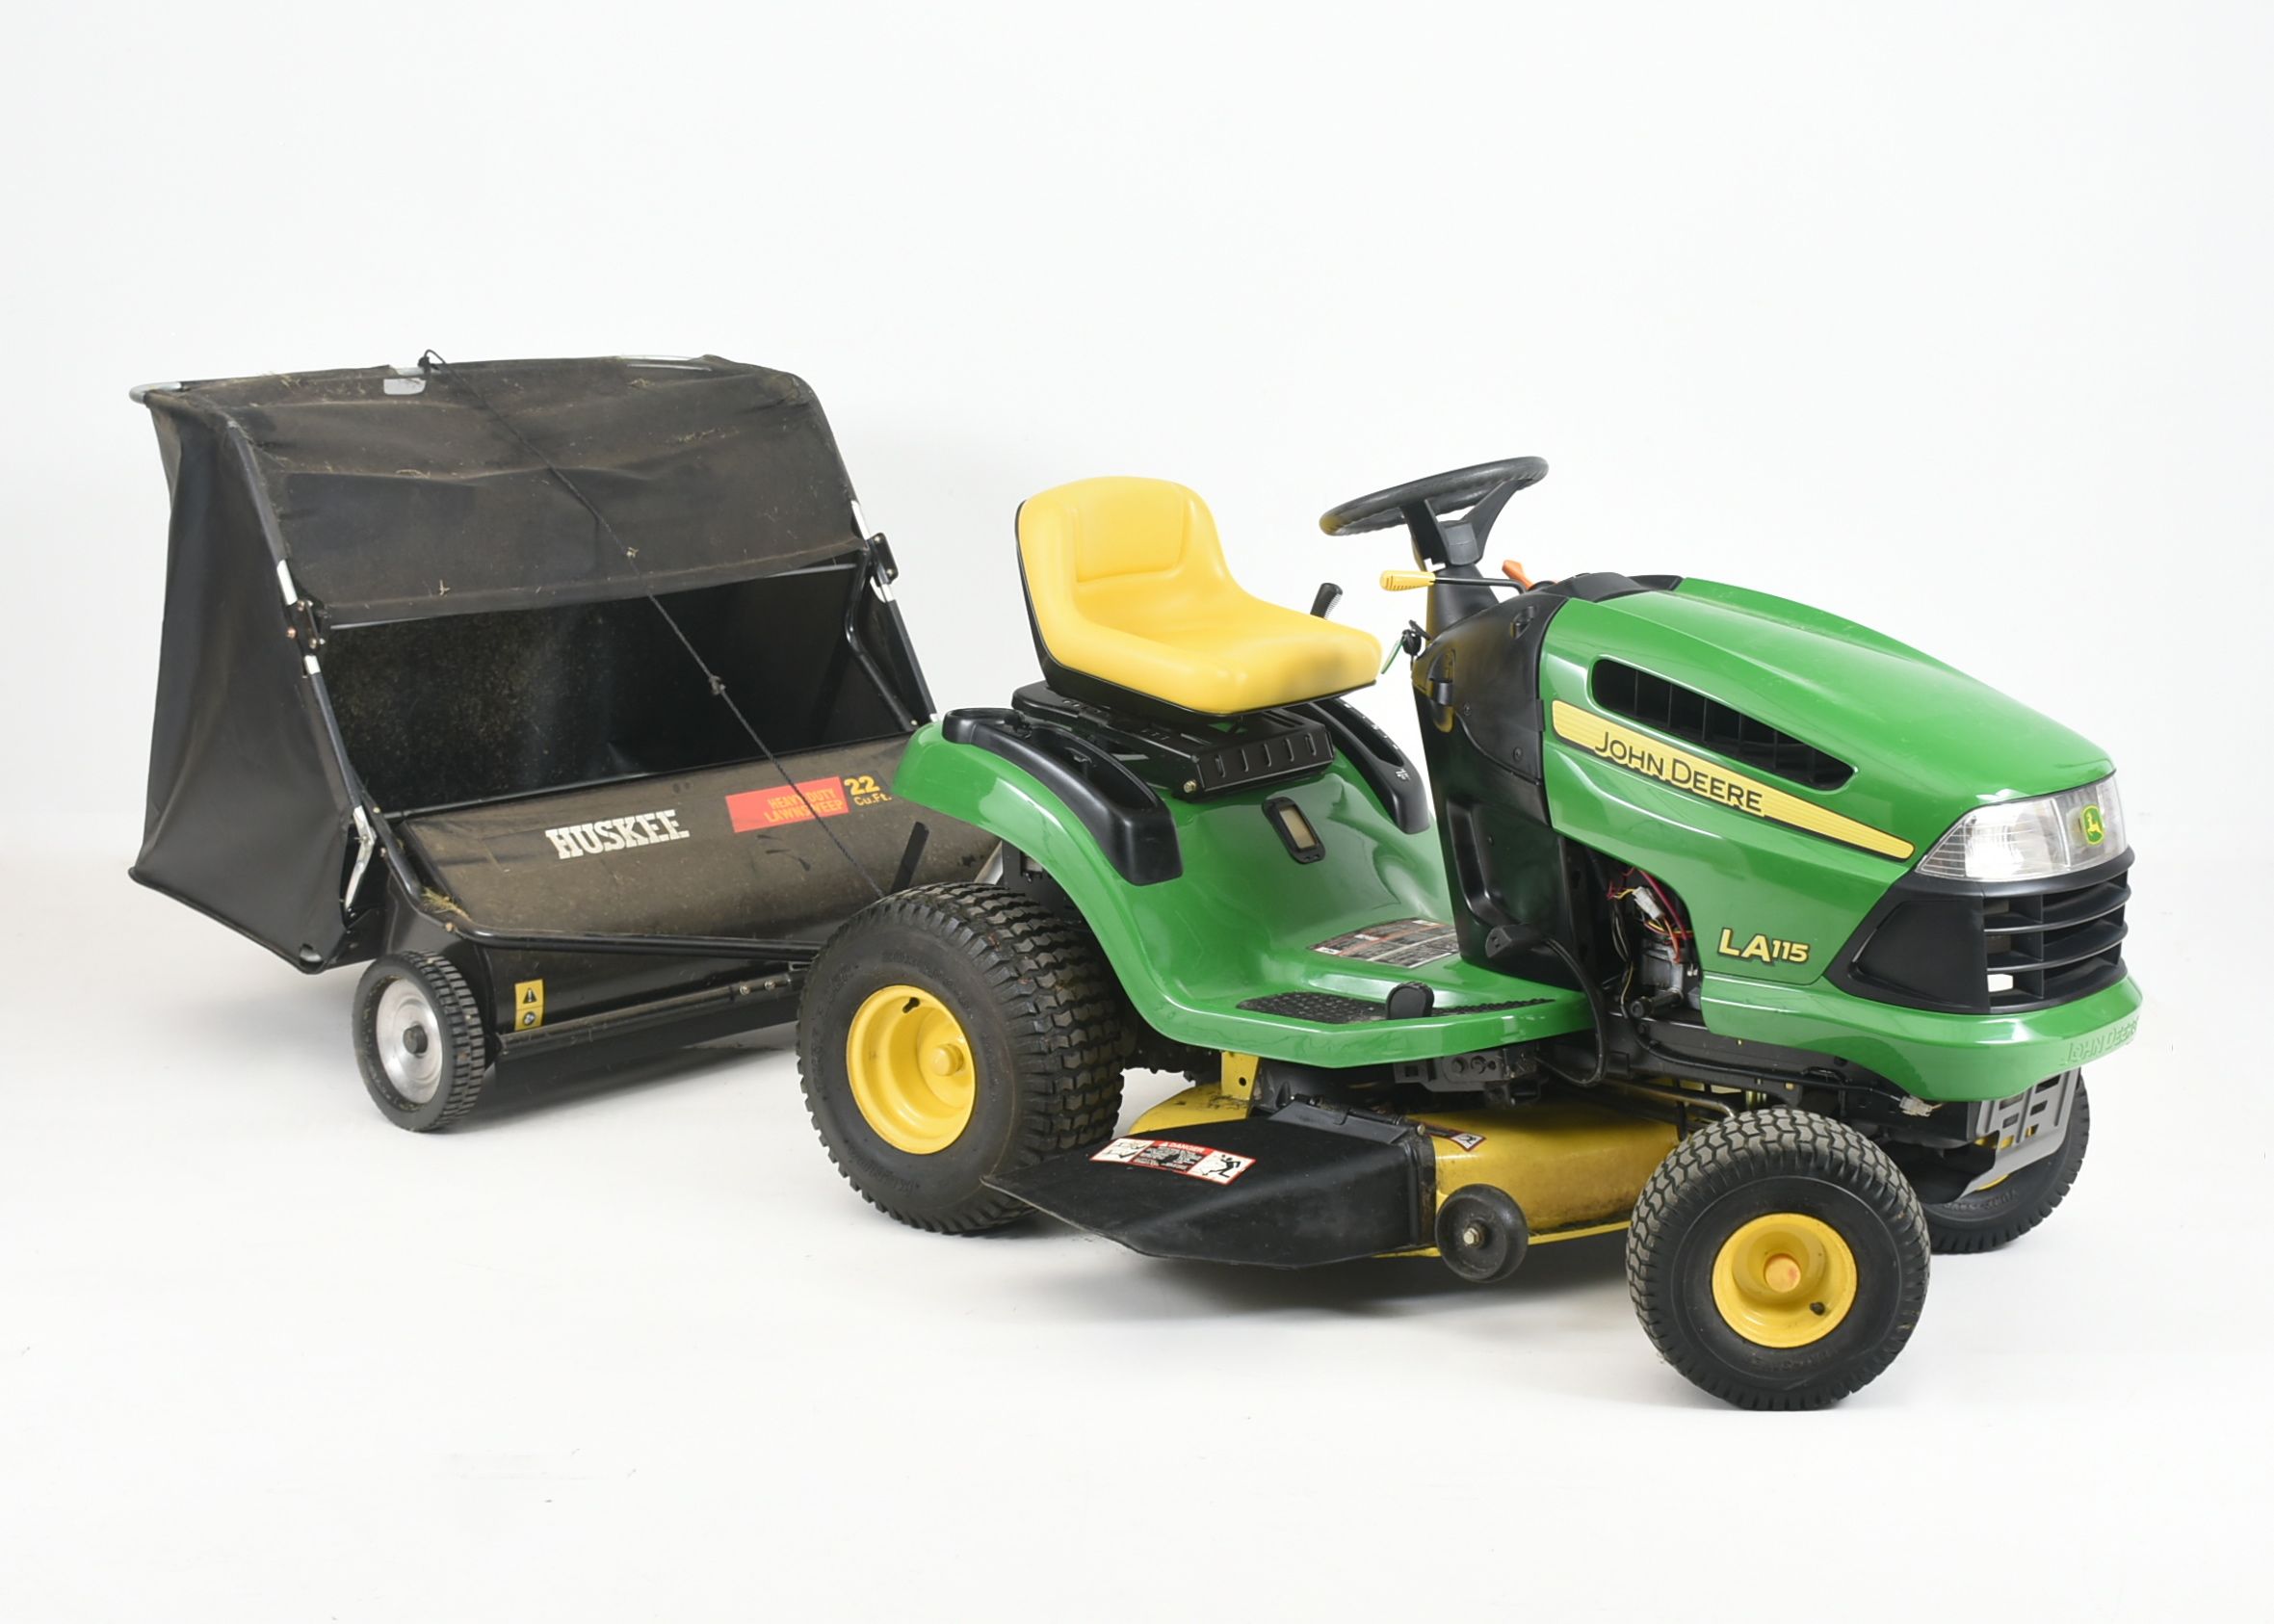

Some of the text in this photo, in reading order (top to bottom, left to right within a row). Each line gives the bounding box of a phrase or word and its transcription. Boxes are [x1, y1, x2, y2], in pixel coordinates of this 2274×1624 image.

[844, 775, 880, 796] 22
[1595, 732, 1763, 812] JOHN DEERE
[805, 788, 836, 802] DUTY
[853, 793, 892, 806] Cu.Ft.
[545, 809, 691, 859] HUSKEE
[1718, 929, 1810, 963] LA115
[2059, 1035, 2104, 1065] JOHN
